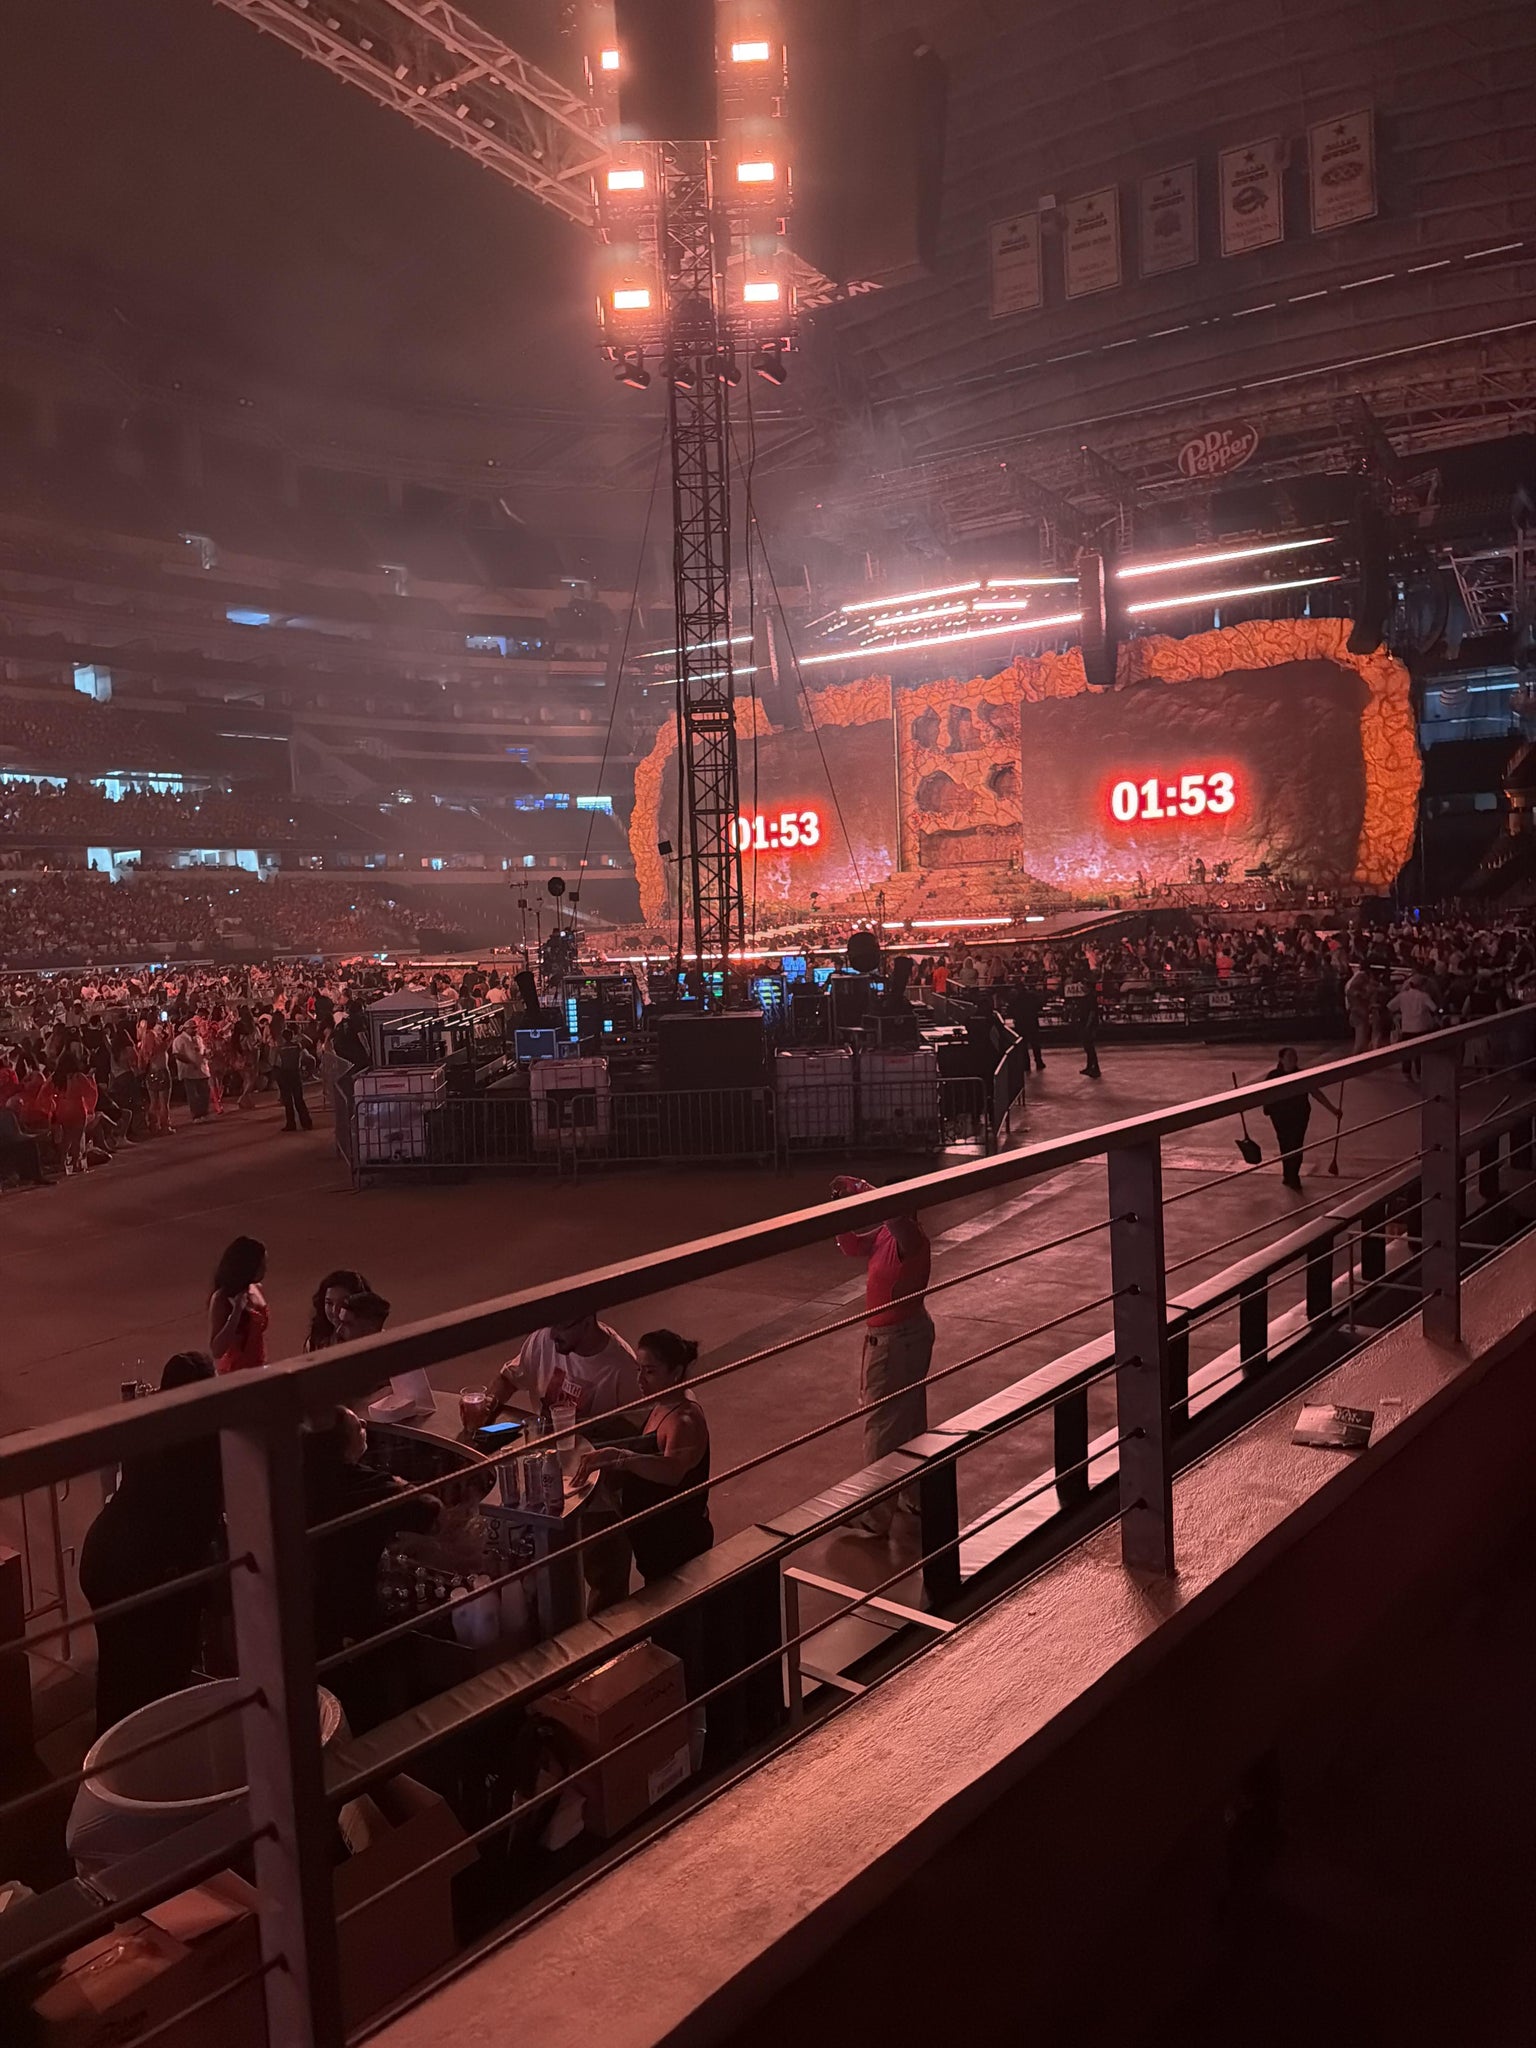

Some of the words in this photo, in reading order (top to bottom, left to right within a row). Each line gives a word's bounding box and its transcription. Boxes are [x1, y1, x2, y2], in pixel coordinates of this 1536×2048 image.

[1178, 434, 1252, 476] Pepper
[1204, 430, 1233, 453] Dr
[1111, 771, 1236, 822] 01:53
[731, 811, 820, 852] 01:53
